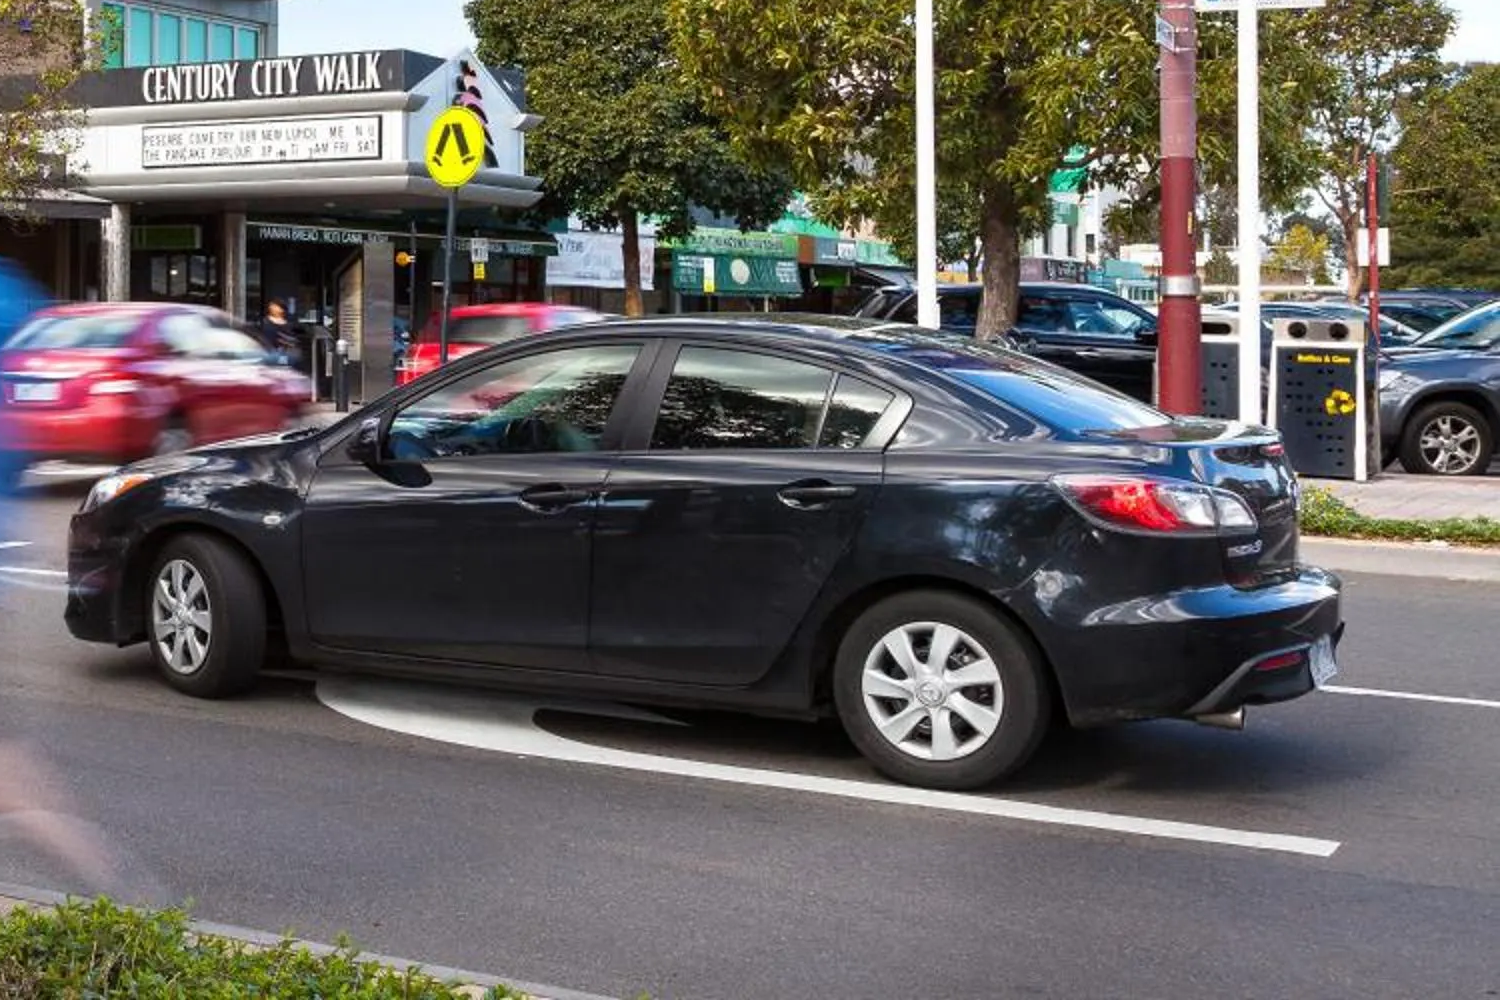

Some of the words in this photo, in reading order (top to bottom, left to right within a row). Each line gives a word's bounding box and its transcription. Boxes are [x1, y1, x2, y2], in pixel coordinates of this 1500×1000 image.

[143, 62, 240, 103] CENTURY
[251, 57, 303, 97] CITY
[313, 52, 382, 92] WALK
[217, 130, 235, 144] TRY
[261, 128, 283, 142] NEW
[285, 126, 318, 141] LUNCH
[144, 148, 160, 161] THE
[165, 146, 205, 161] PANCAKE
[333, 142, 349, 153] FRI
[358, 139, 376, 153] SAT
